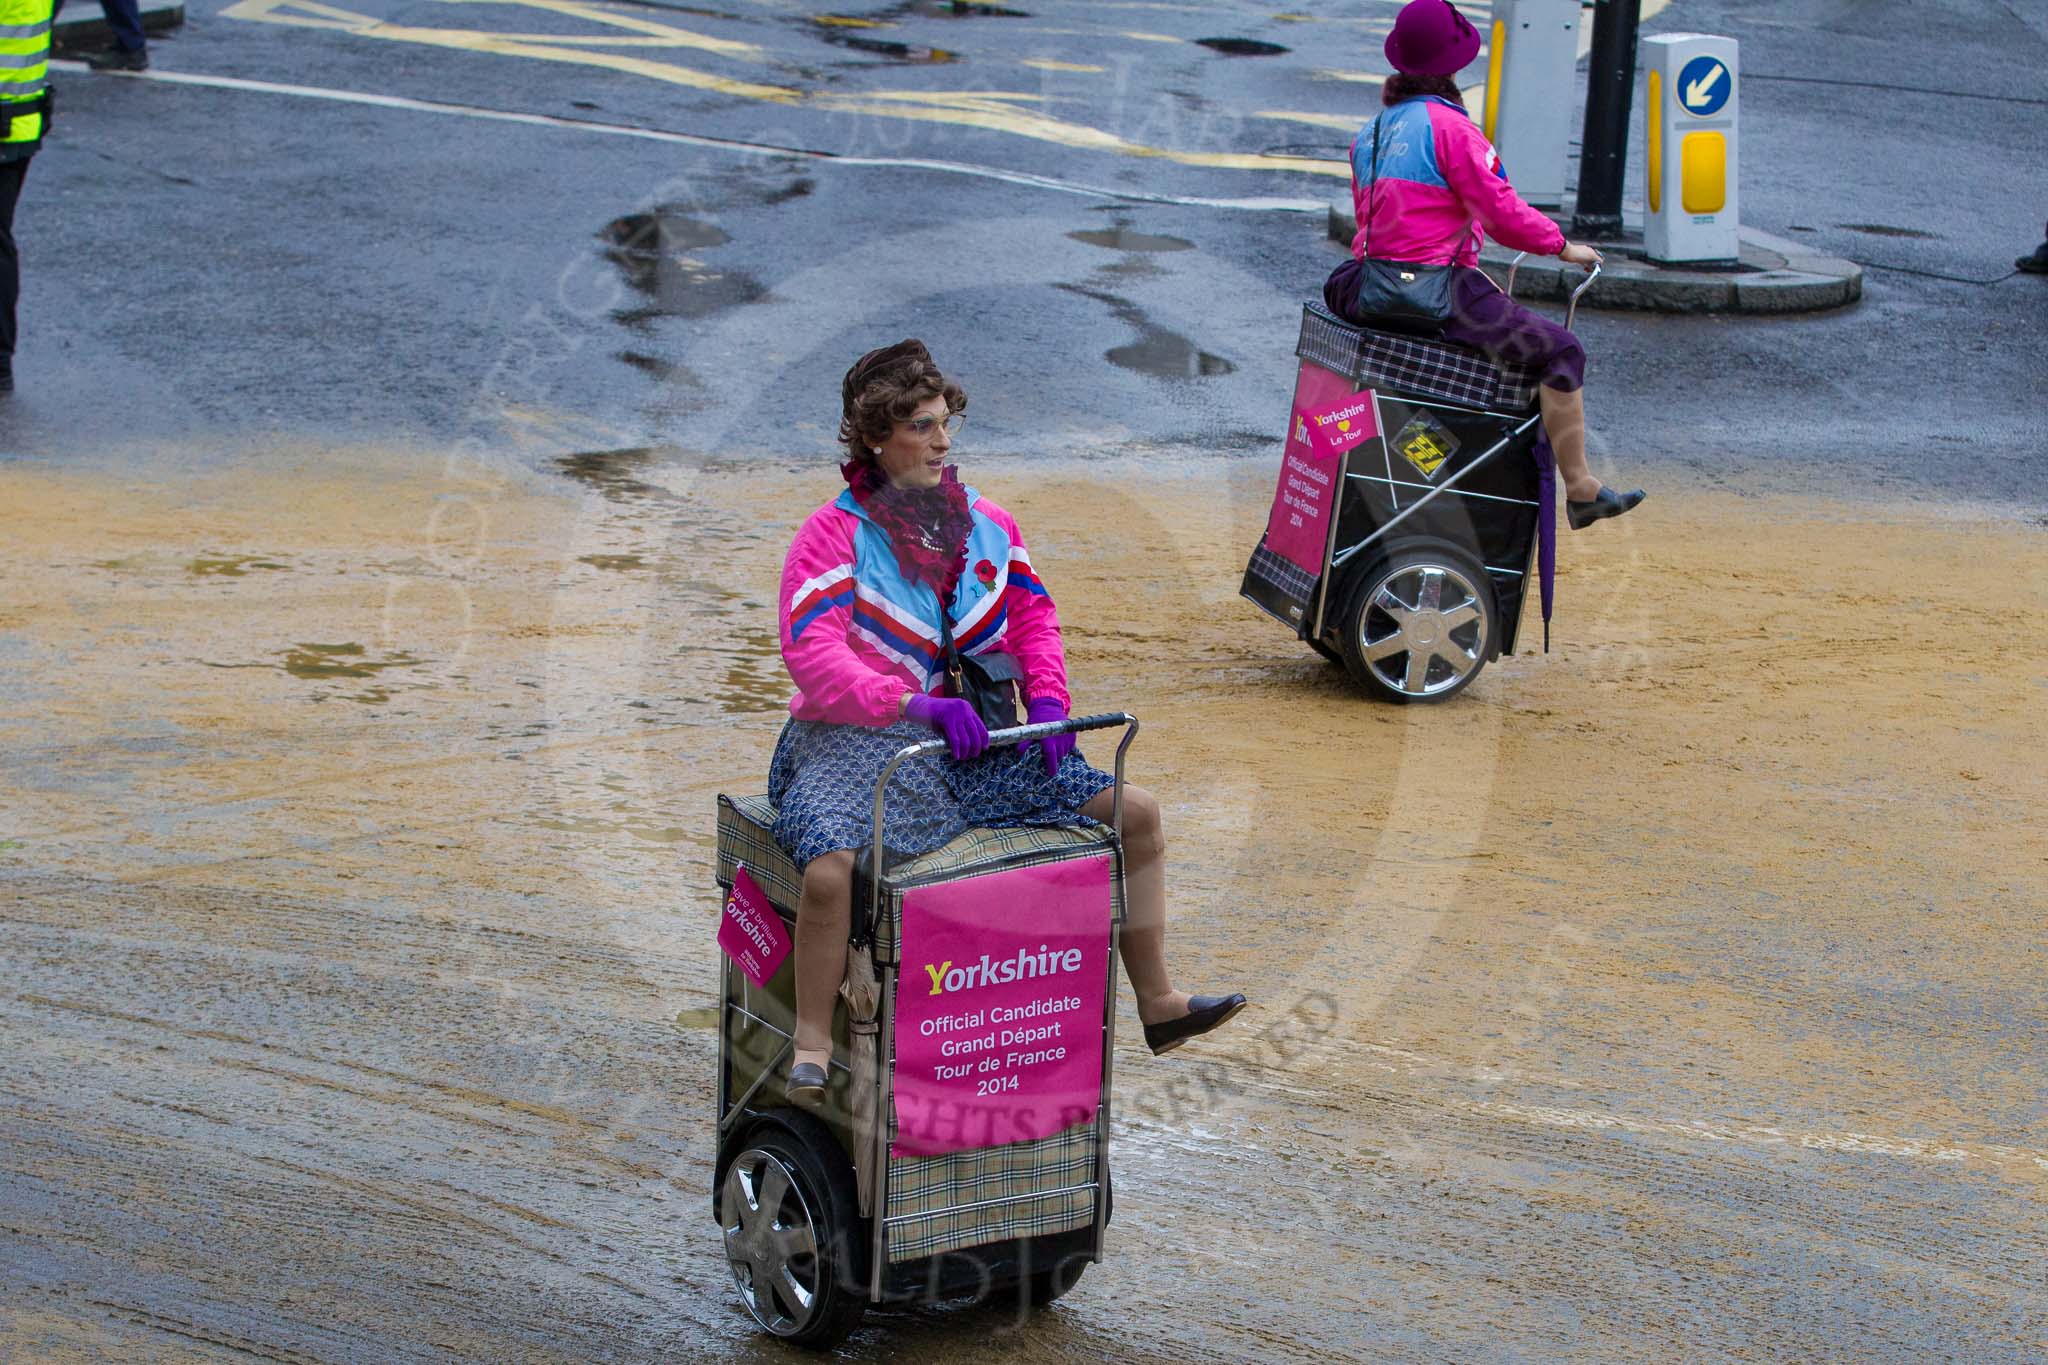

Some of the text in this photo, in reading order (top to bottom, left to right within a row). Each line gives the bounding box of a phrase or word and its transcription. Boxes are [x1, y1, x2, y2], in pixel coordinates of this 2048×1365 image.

[1314, 404, 1365, 427] Yorkshire
[1330, 428, 1362, 446] Le Tour
[748, 906, 756, 915] a
[754, 913, 778, 948] brilliant
[925, 944, 1082, 996] Yorkshire
[920, 995, 1081, 1037] Official Candidate
[941, 1021, 1061, 1057] Grand Départ
[934, 1046, 1066, 1081] Tour de France
[977, 1075, 1020, 1097] 2014
